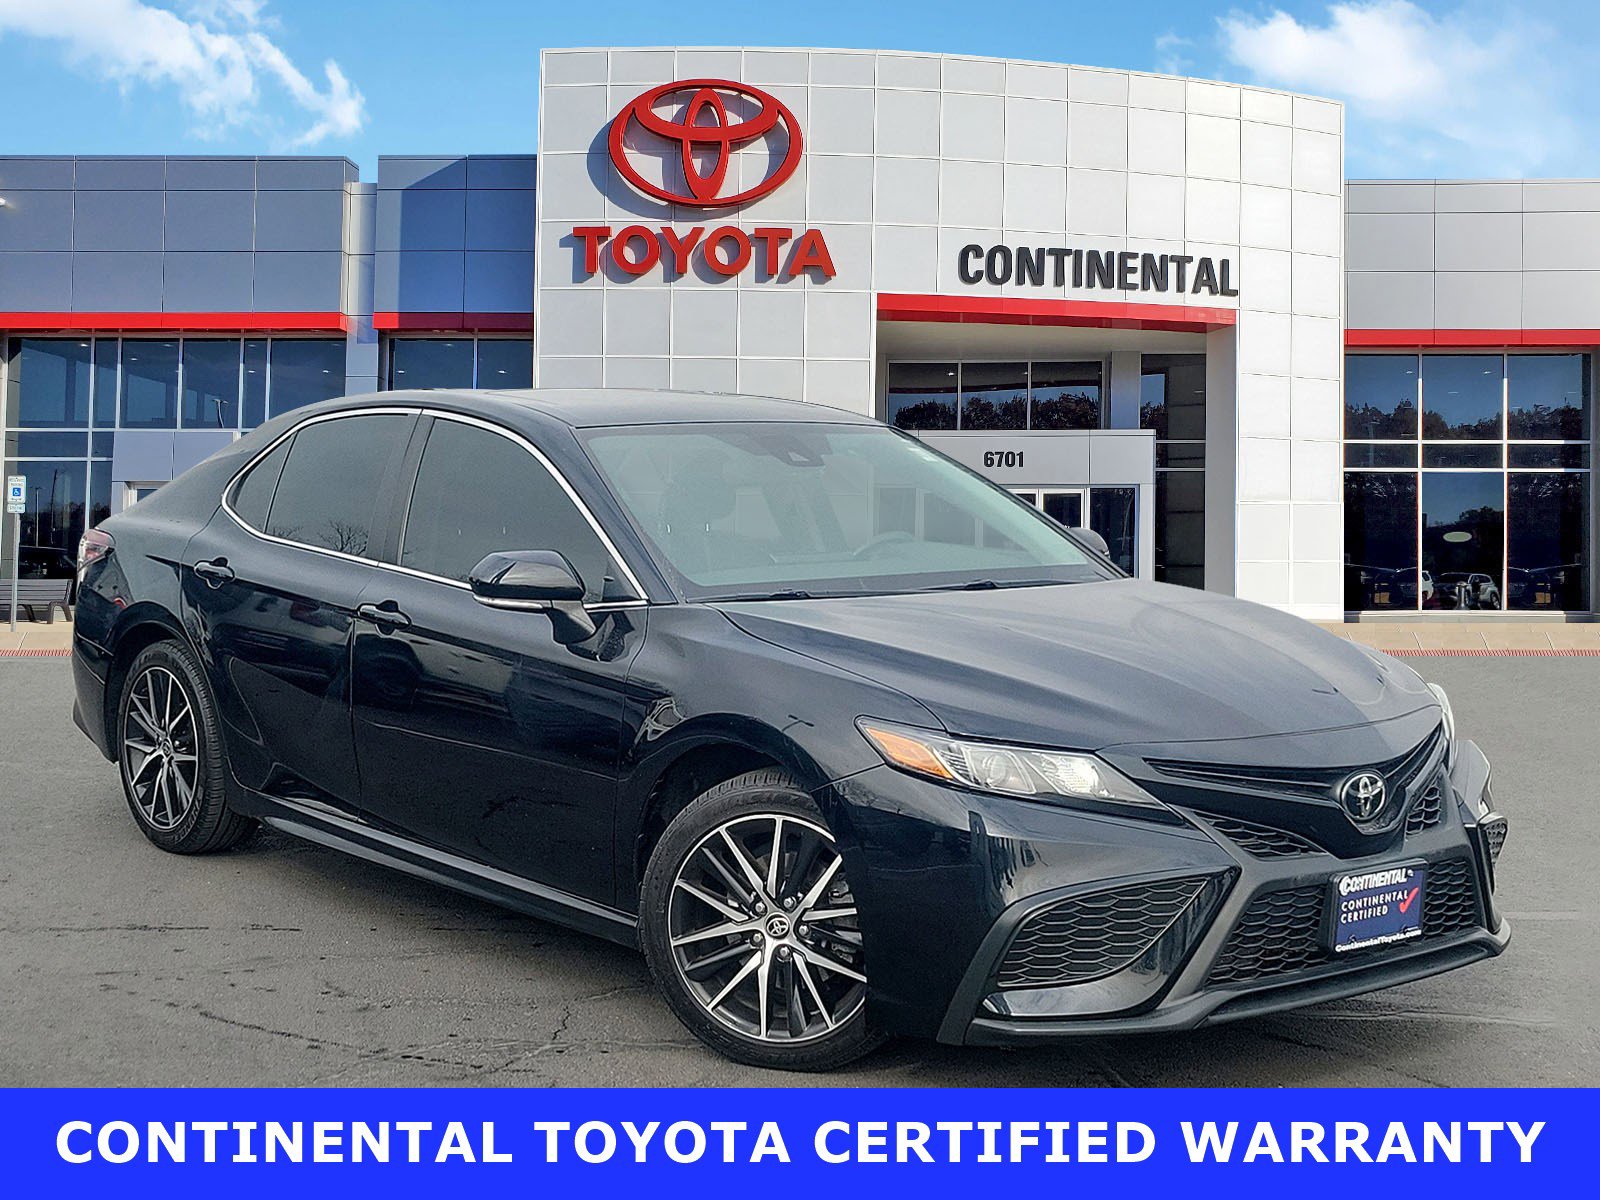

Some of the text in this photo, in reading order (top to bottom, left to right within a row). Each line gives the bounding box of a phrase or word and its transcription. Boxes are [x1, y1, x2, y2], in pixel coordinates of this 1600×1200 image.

[573, 225, 836, 276] TOYOTA
[958, 244, 1239, 296] CONTINENTAL
[983, 451, 1024, 468] 6701
[1339, 868, 1407, 896] CONTINENTAL
[1341, 890, 1408, 911] CONTINENTAL
[1340, 905, 1388, 923] CERTIFIED
[1335, 929, 1421, 952] ContinentalToyota.com
